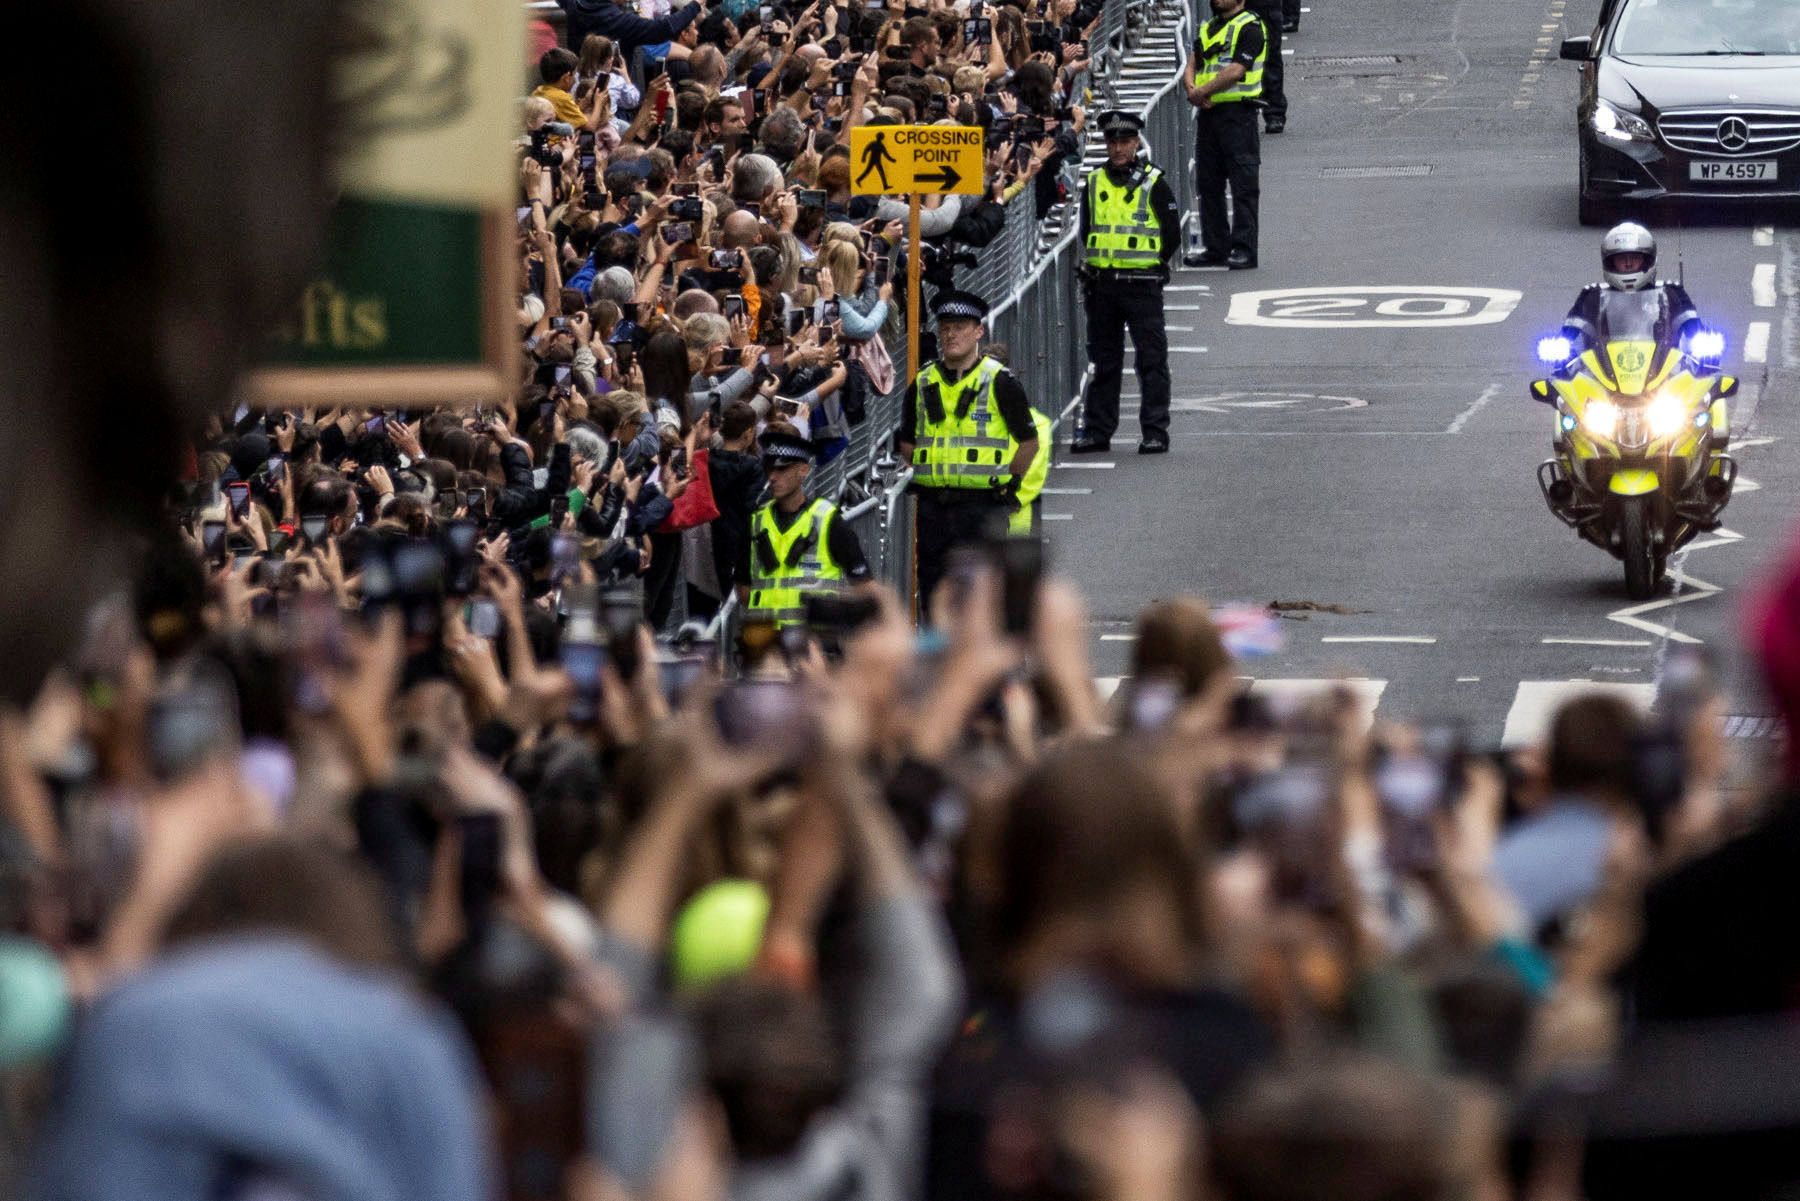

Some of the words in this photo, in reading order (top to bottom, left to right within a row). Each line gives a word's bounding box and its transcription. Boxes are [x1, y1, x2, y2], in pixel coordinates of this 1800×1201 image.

[894, 130, 981, 146] CROSSING
[913, 149, 961, 163] POINT
[1701, 163, 1721, 179] WP
[1726, 163, 1767, 179] 4597
[1270, 298, 1471, 317] 20
